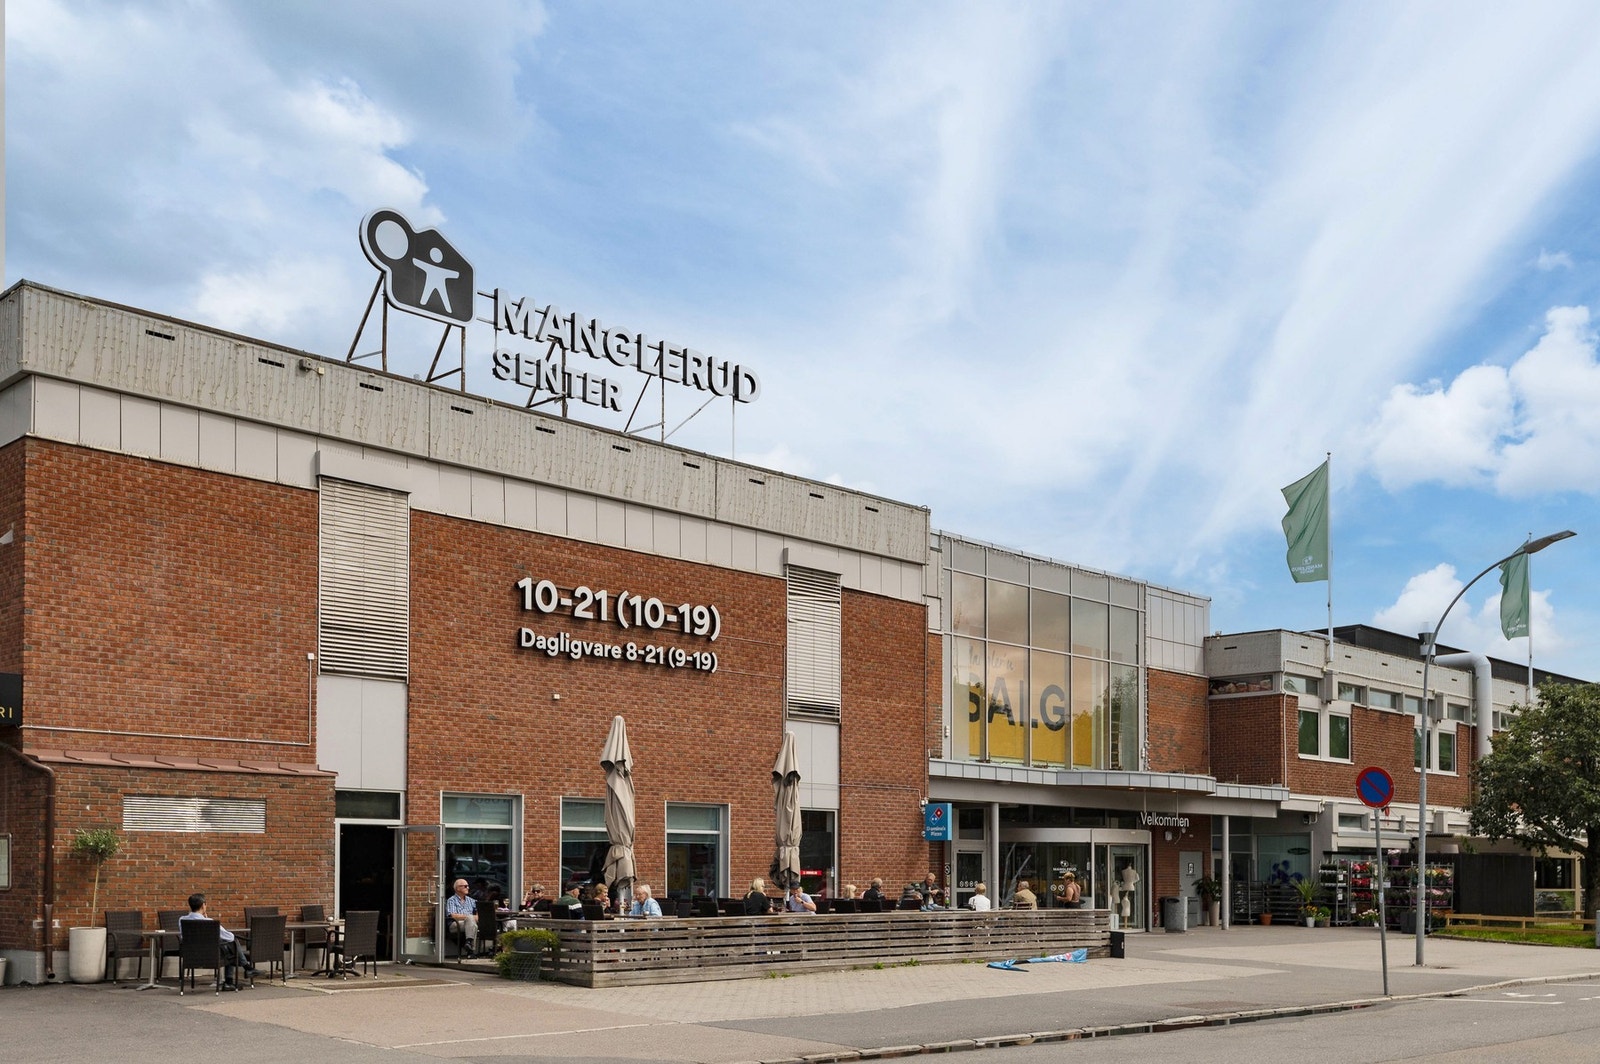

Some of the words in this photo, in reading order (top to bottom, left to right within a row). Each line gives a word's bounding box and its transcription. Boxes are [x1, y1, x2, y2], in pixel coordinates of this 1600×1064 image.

[493, 287, 762, 403] MANGLERUD
[492, 348, 623, 411] SENTER
[516, 576, 608, 622] 10-21
[617, 590, 721, 642] (10-19)
[520, 627, 622, 659] Dagligvare
[625, 641, 664, 664] 8-21
[668, 646, 718, 673] (9-19)
[1140, 811, 1190, 827] Velkommen
